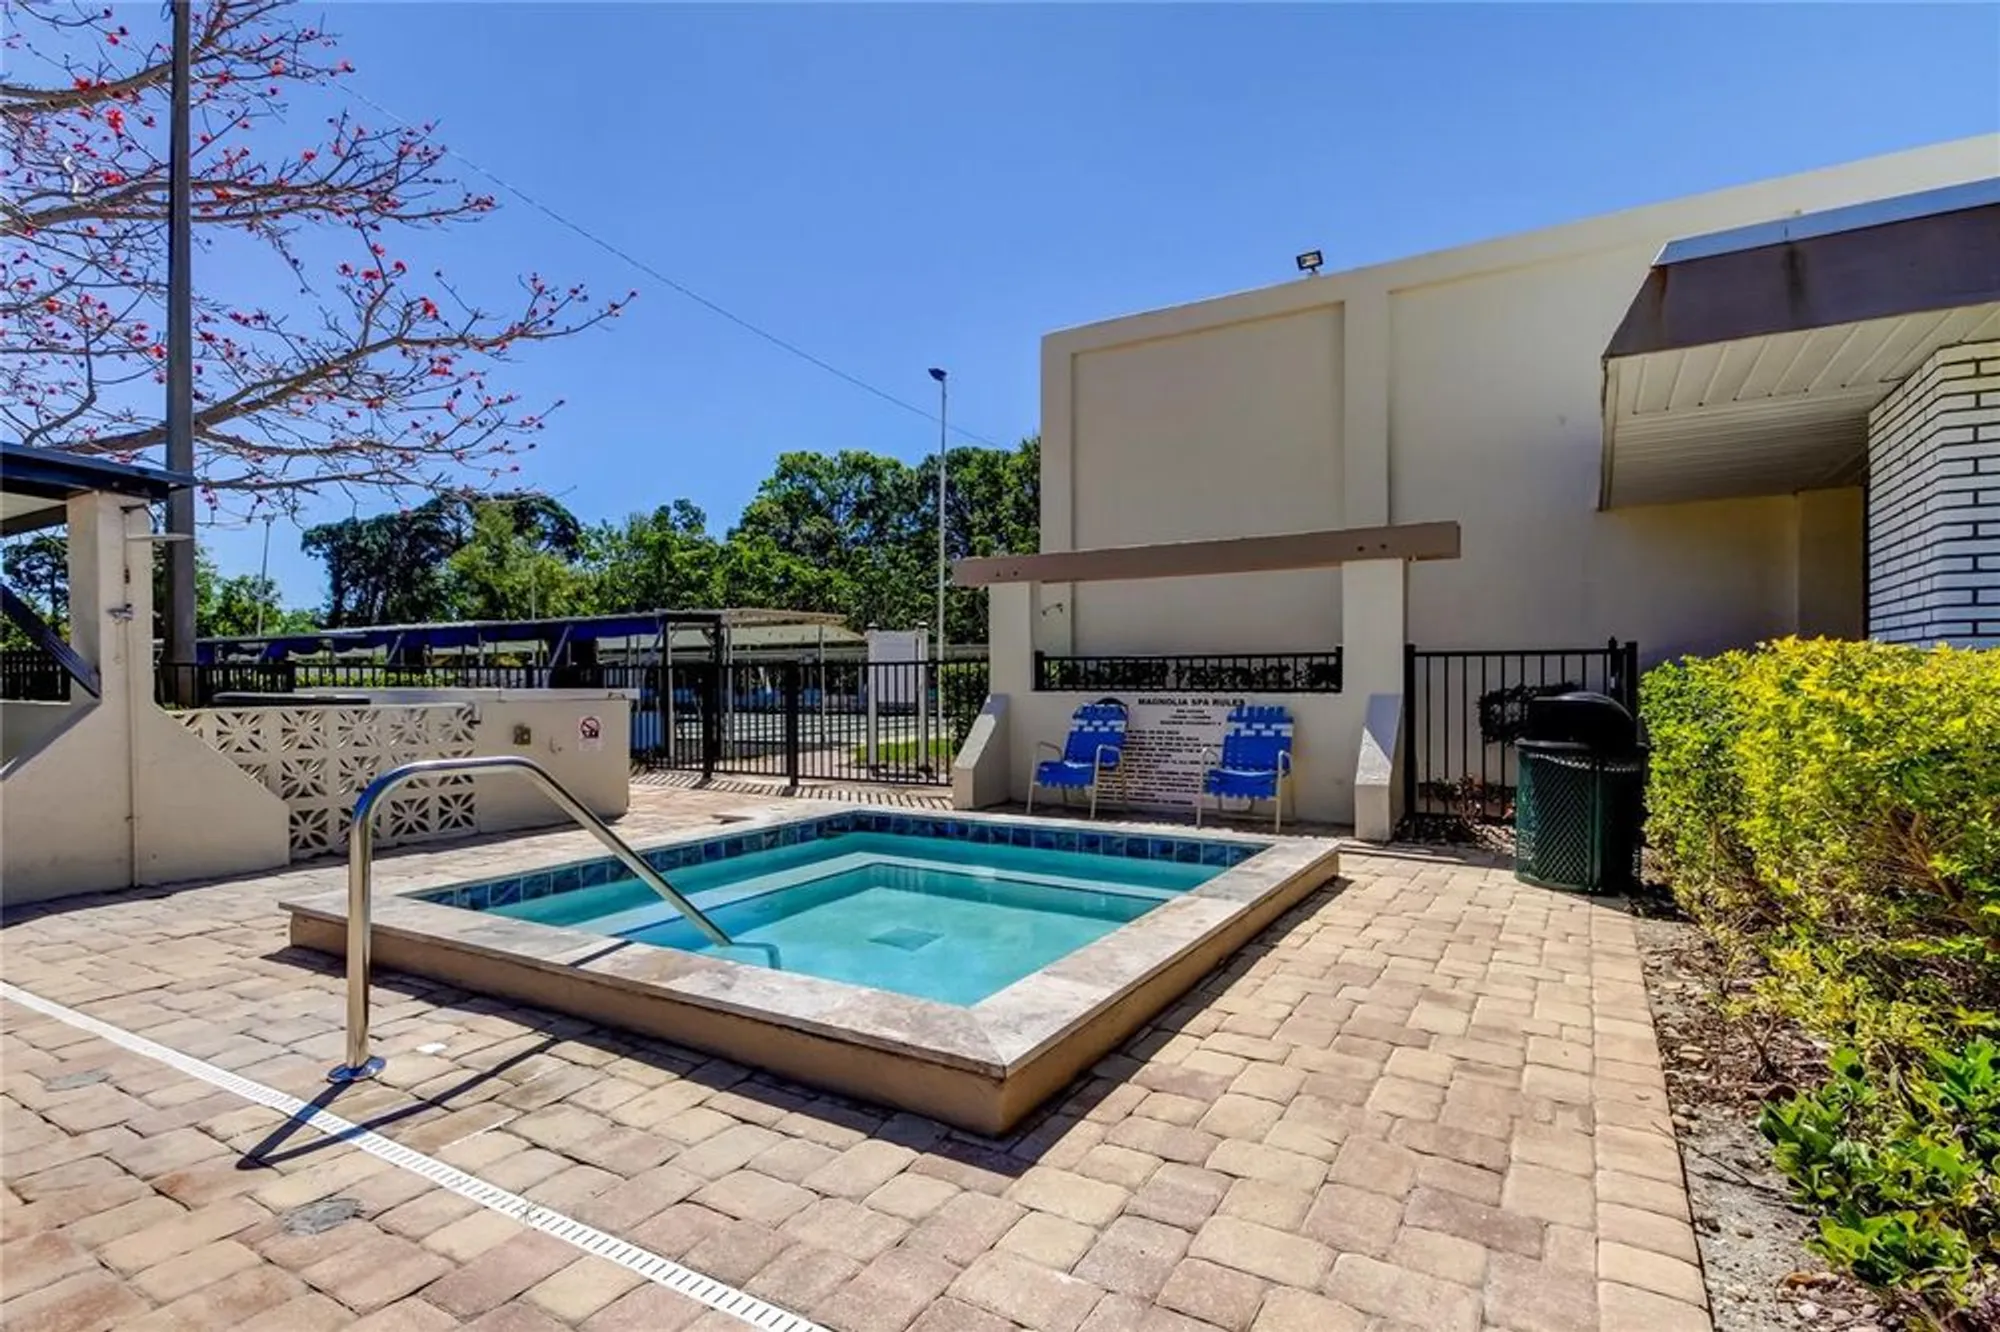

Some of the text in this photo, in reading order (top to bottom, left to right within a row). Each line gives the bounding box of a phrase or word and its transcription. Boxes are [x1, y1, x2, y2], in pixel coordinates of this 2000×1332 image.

[1138, 698, 1246, 707] MAGNOLIA SPA RULES
